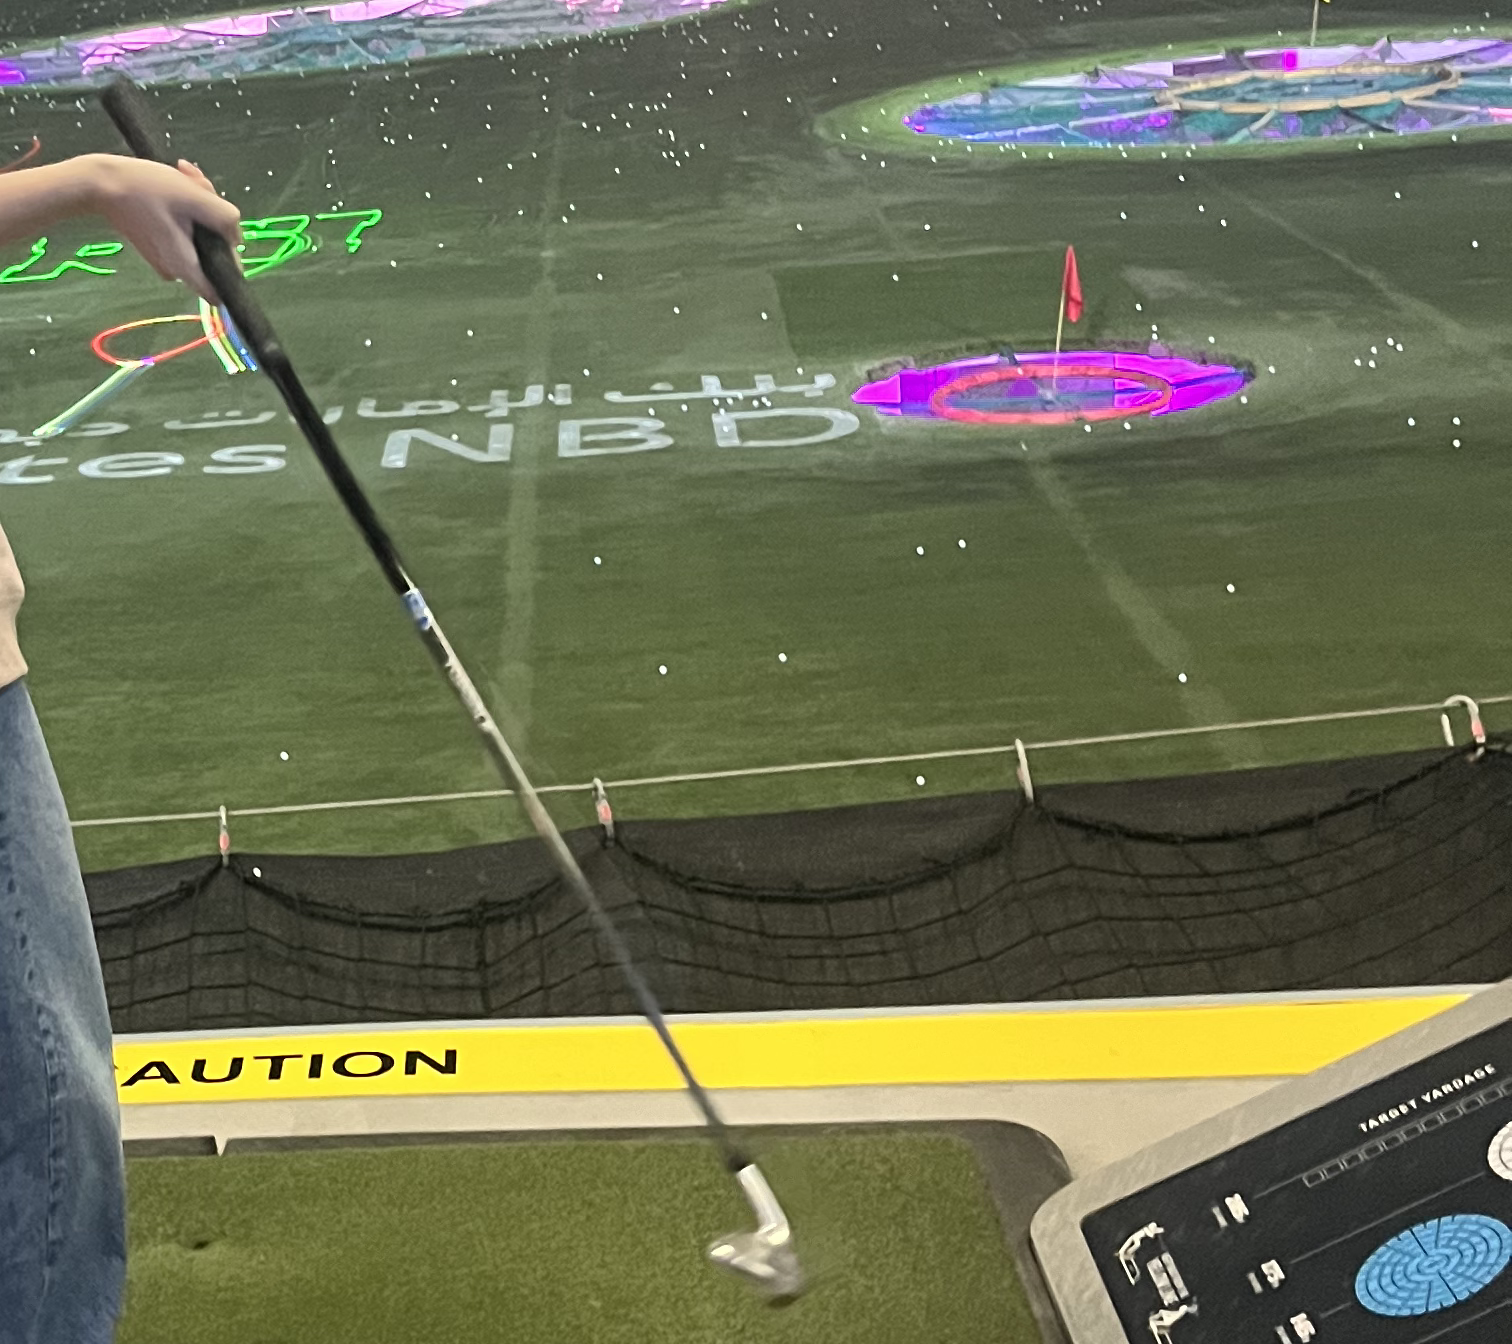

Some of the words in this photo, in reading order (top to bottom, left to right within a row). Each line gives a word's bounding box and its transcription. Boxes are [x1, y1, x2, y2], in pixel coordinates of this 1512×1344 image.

[381, 407, 860, 468] NBD
[115, 1049, 458, 1087] AUTION
[1358, 1098, 1418, 1133] TARGET
